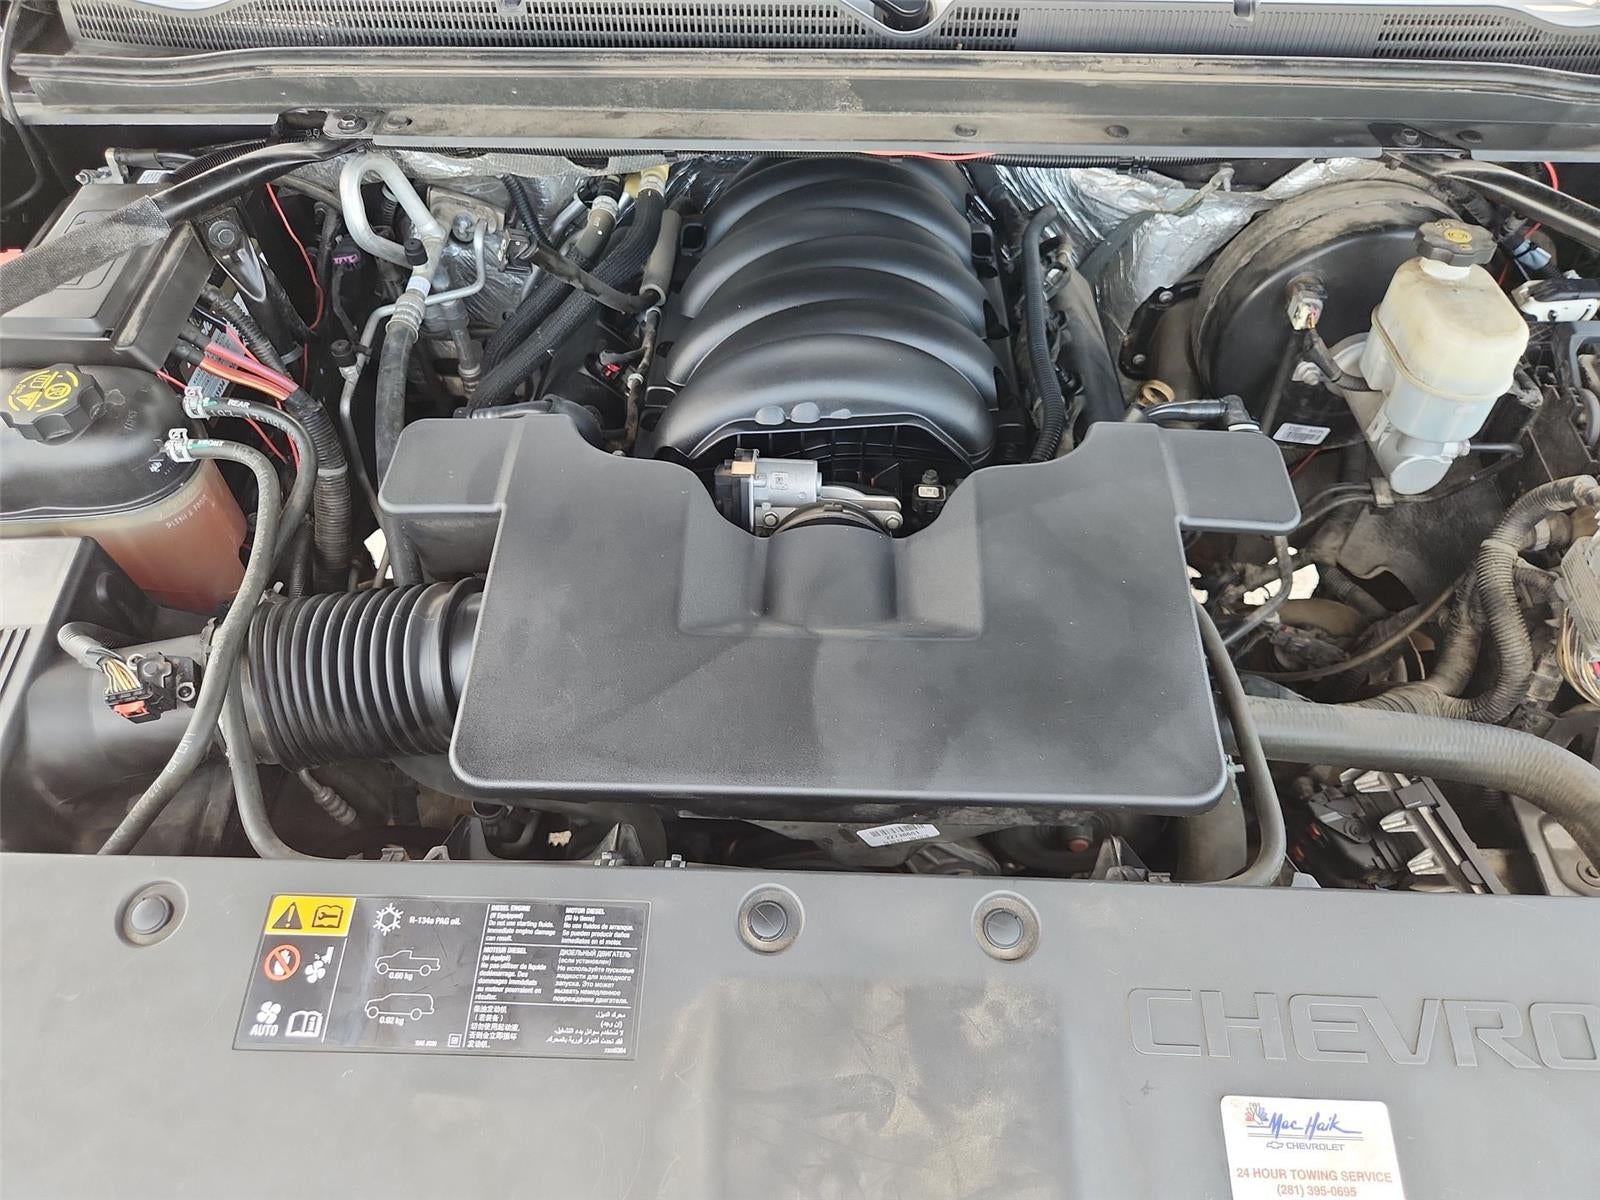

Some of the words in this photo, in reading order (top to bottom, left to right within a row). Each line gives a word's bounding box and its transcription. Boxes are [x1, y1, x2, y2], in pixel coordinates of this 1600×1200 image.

[227, 399, 250, 408] REAR
[491, 904, 510, 912] DIESEL
[409, 916, 435, 925] R-134a
[435, 917, 450, 925] PAG
[517, 920, 538, 928] starting
[609, 924, 634, 932] arranque.
[597, 950, 632, 958] ДВИГАТЕЛЬ
[478, 978, 508, 986] dommages
[250, 1024, 279, 1037] AUTO
[1127, 987, 1600, 1071] CHEVRO
[1269, 1112, 1304, 1139] Mac
[1304, 1112, 1360, 1140] Haik
[1286, 1142, 1345, 1151] CHEVROLET
[1236, 1168, 1250, 1178] 24
[1253, 1168, 1287, 1180] HOUR
[1290, 1169, 1338, 1181] TOWING
[1340, 1171, 1393, 1183] SERVICE
[1277, 1184, 1305, 1198] (281)
[1307, 1185, 1357, 1197] 395-0695
